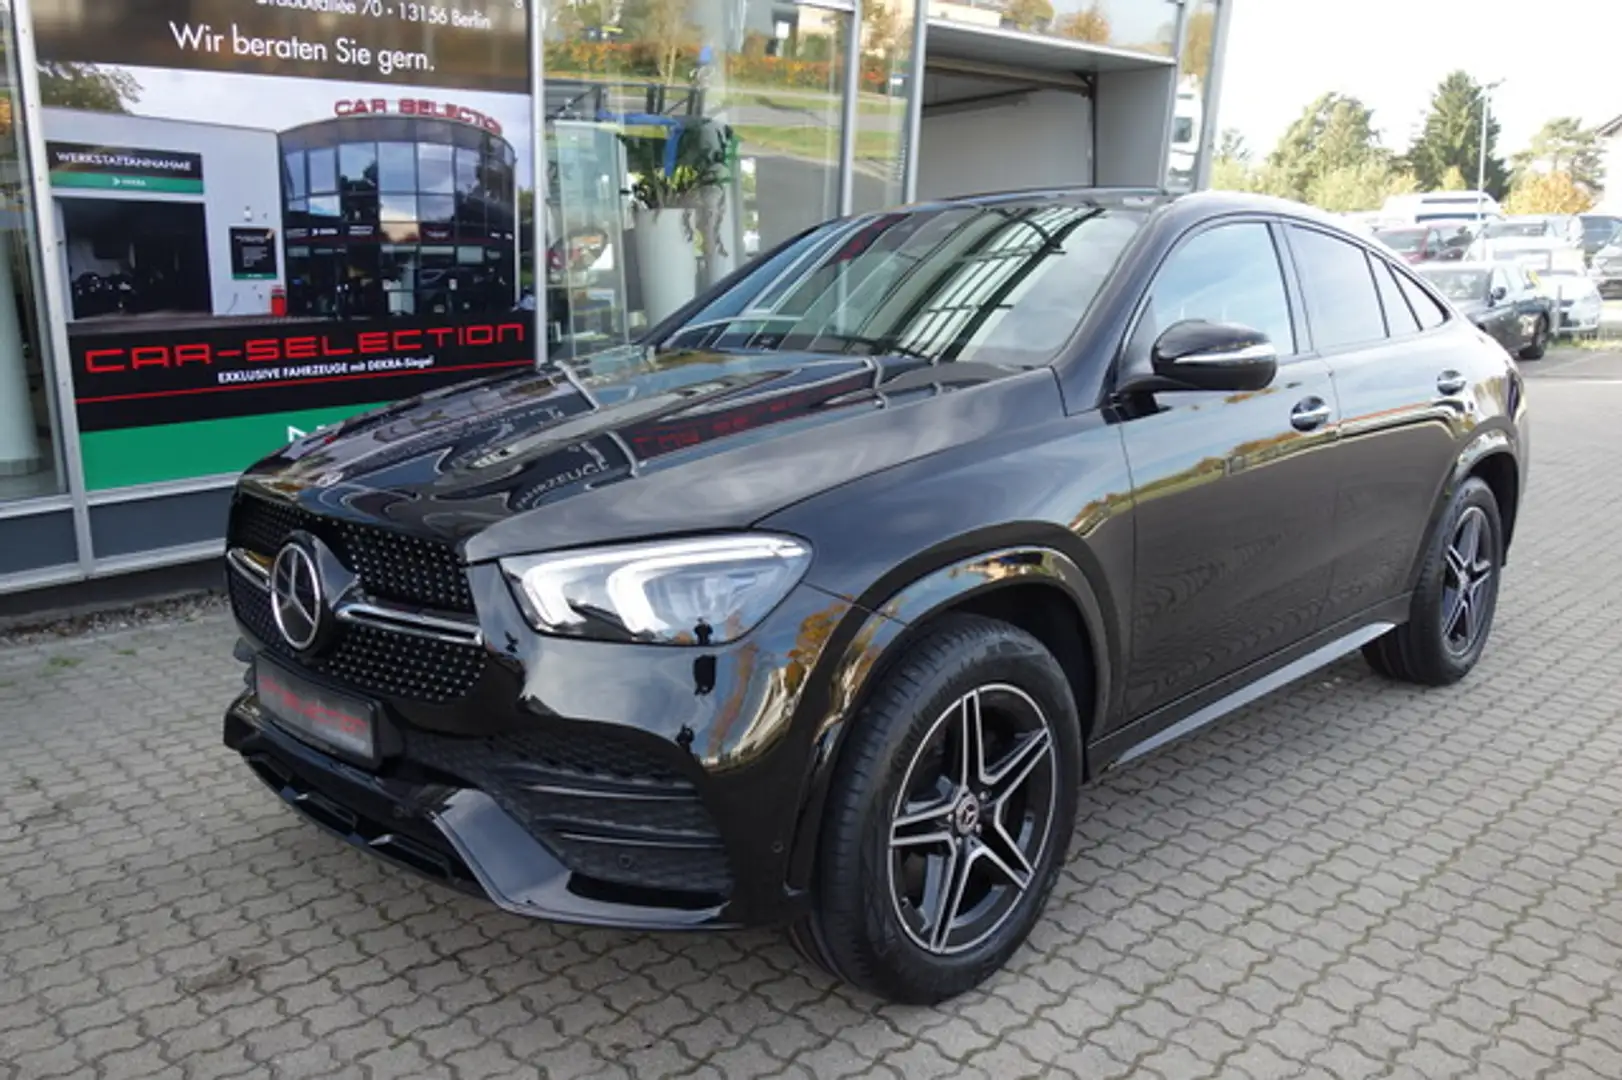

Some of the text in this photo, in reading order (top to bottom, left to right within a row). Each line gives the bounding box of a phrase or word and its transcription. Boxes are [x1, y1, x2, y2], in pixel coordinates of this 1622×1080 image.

[399, 2, 448, 25] 13156
[451, 7, 492, 30] Berlin
[169, 20, 436, 75] Wir beraten Sie gern.
[334, 98, 387, 116] CAR
[84, 322, 525, 373] CAR-SELECTION
[217, 367, 281, 384] EXKLUSIVE
[283, 362, 348, 378] FAHRZEUGE
[349, 360, 366, 371] mit
